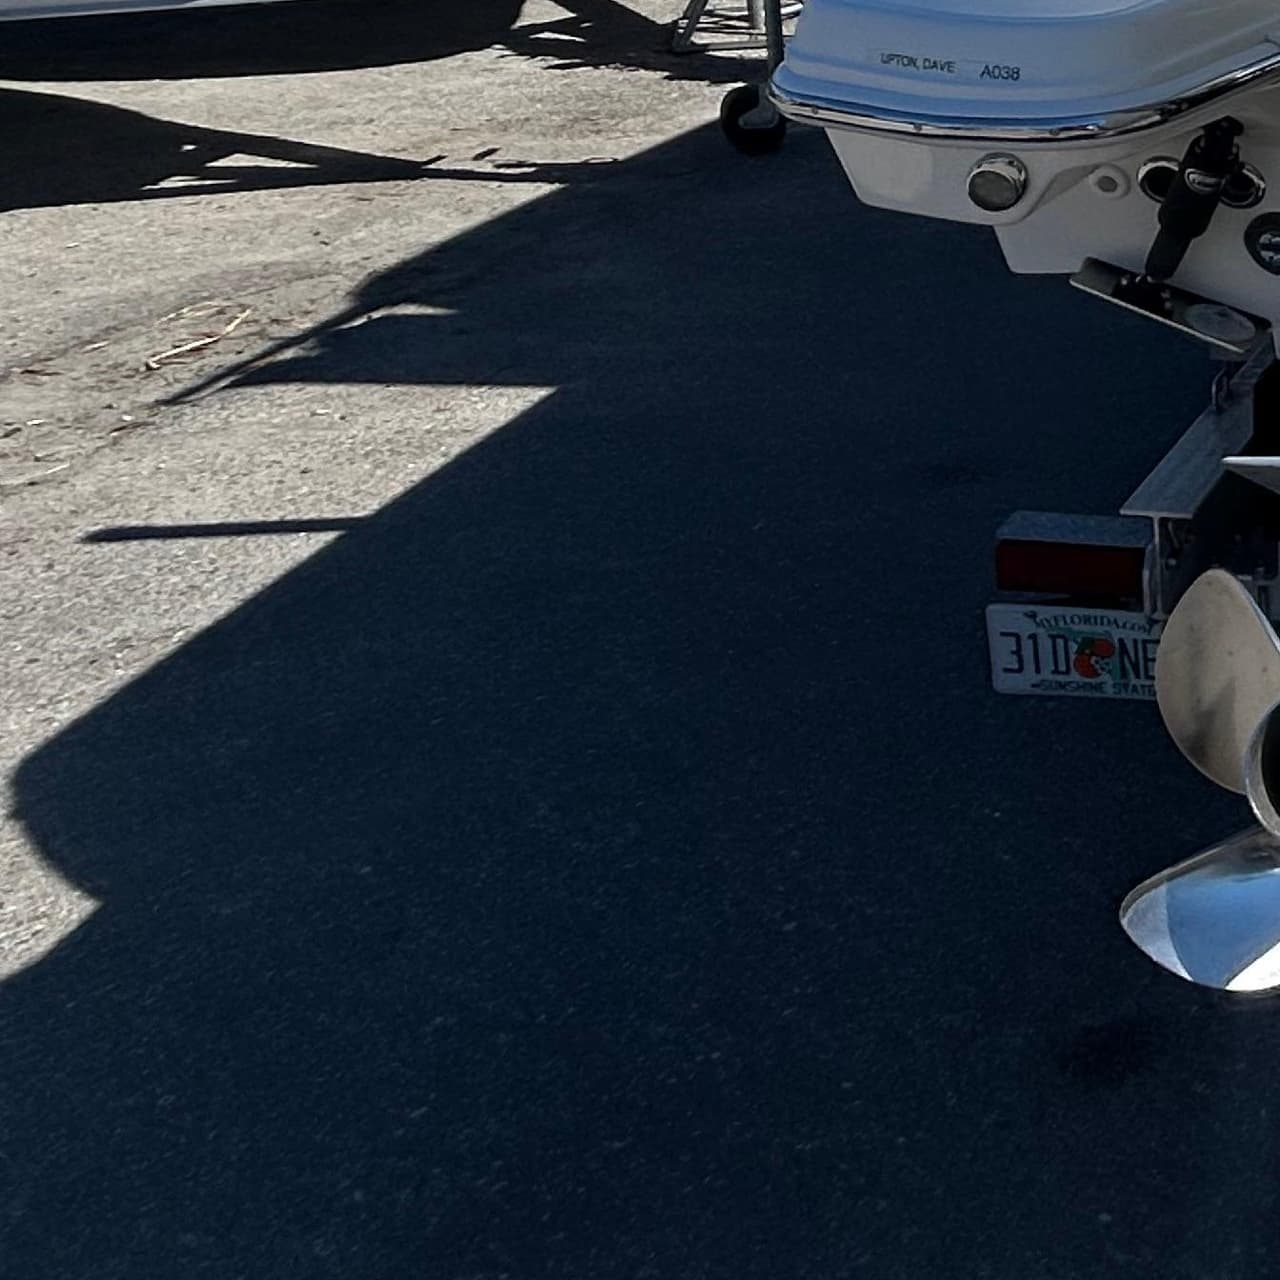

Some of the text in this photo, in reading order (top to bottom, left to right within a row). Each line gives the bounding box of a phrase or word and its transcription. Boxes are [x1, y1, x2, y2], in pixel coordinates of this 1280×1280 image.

[922, 57, 957, 74] DAVE
[979, 64, 1021, 82] A038
[1000, 631, 1072, 675] 31D
